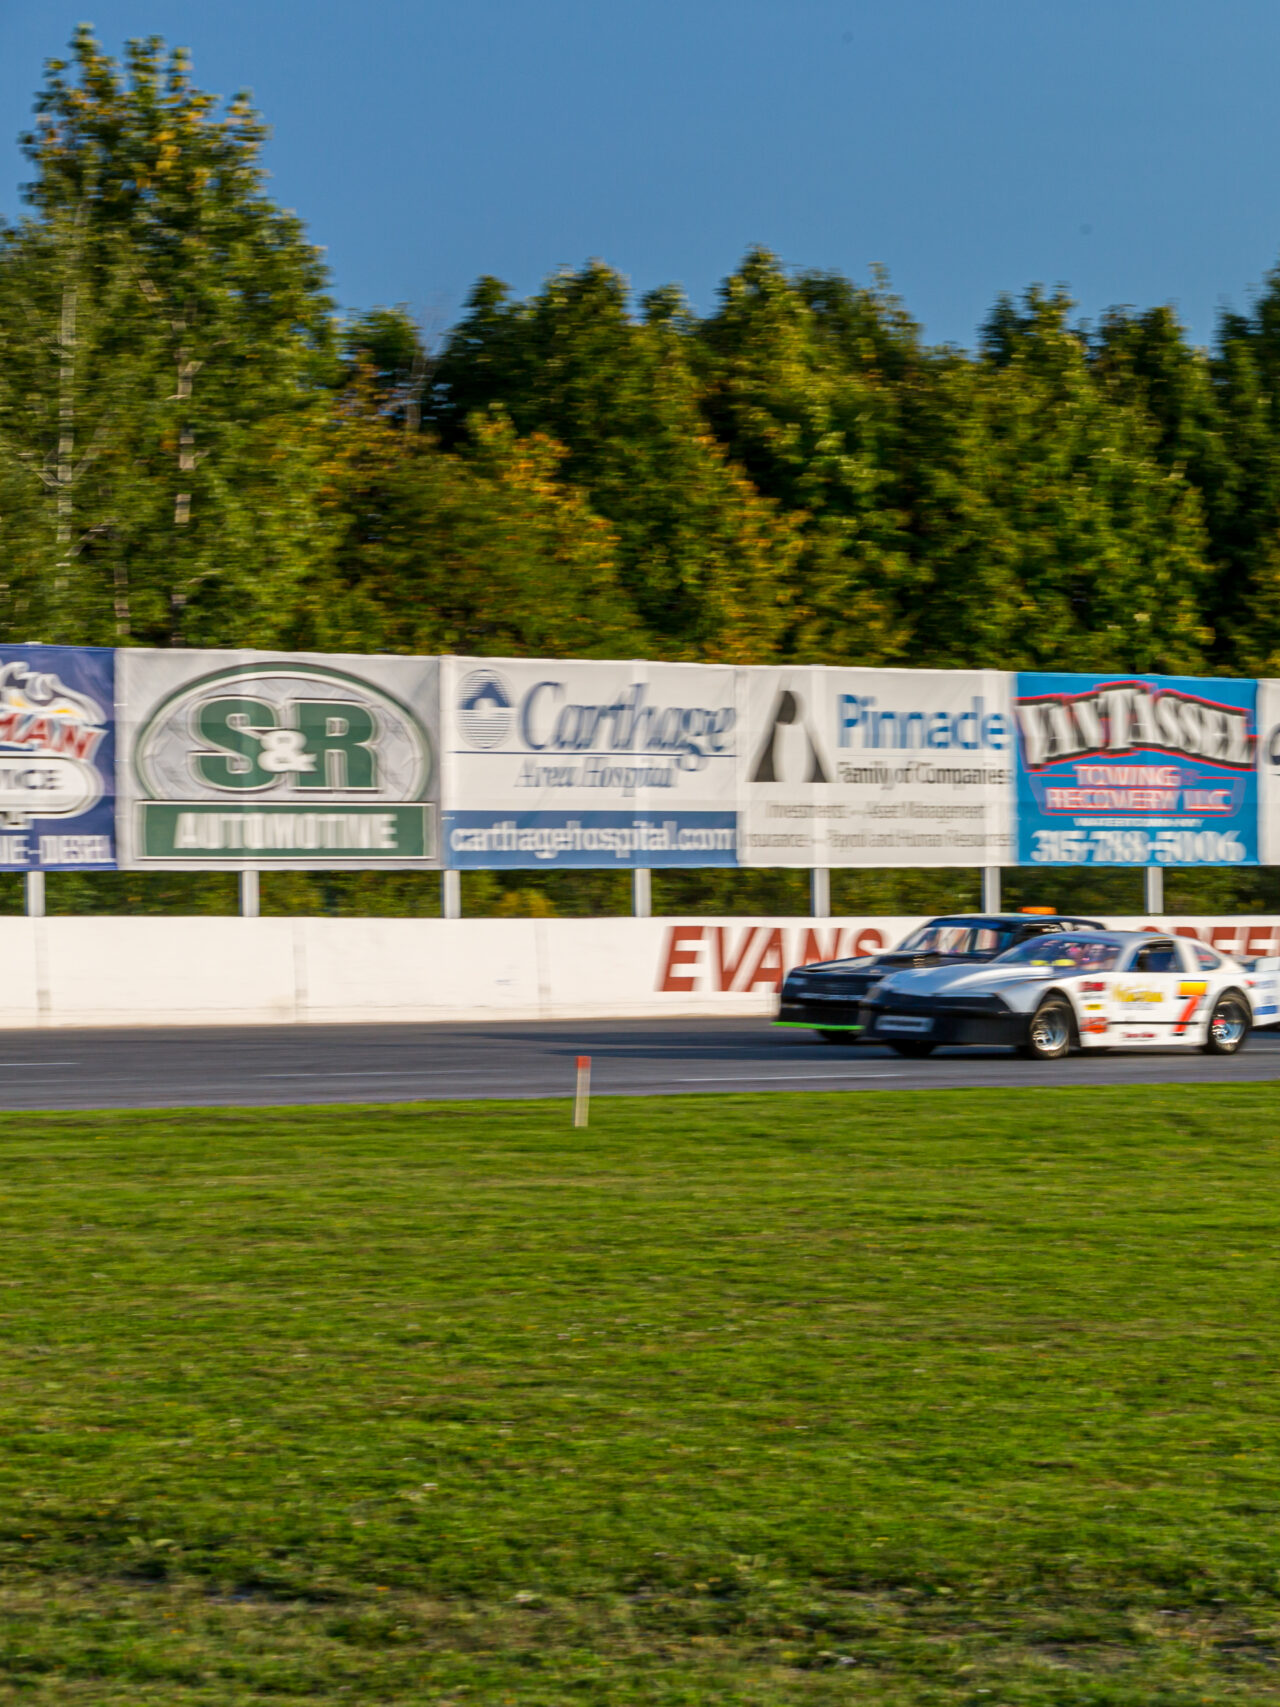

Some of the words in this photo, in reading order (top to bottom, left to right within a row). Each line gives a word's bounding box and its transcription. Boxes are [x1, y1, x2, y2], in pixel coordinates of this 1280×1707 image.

[187, 694, 382, 793] S&R
[518, 681, 738, 771] Carthage
[837, 693, 1013, 750] Pinnacle
[1045, 787, 1179, 811] RECOVERY
[1181, 789, 1233, 811] LLC
[1072, 764, 1182, 788] TOWING
[174, 812, 399, 849] AUTOMOTIVE
[1173, 979, 1210, 1036] 7
